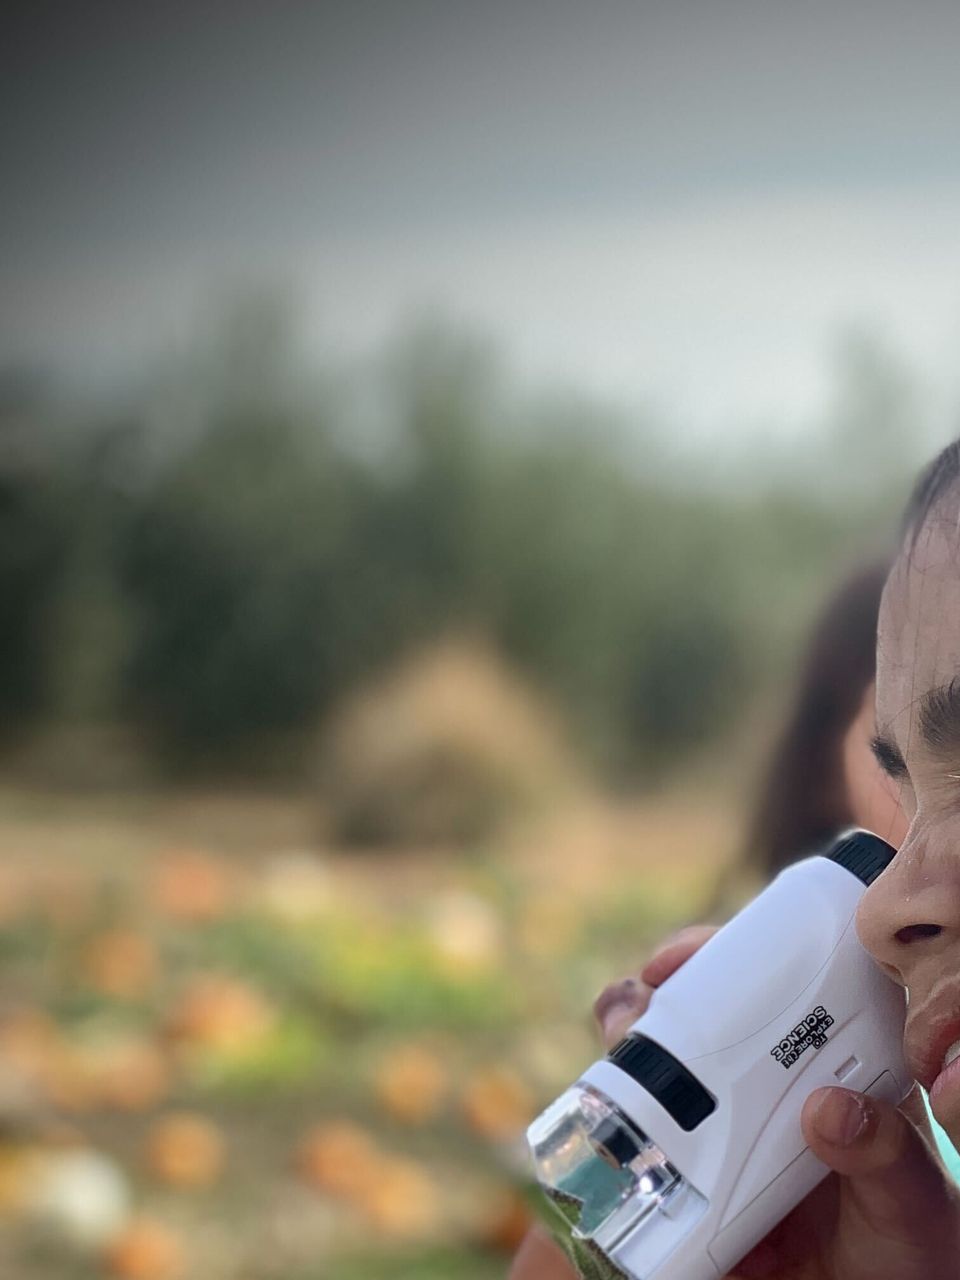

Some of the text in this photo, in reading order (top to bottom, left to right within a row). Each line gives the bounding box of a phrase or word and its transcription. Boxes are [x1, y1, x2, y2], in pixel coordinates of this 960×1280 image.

[771, 1006, 827, 1062] SCIENCE
[795, 1017, 834, 1054] EXPLORE
[812, 1036, 827, 1049] TO
